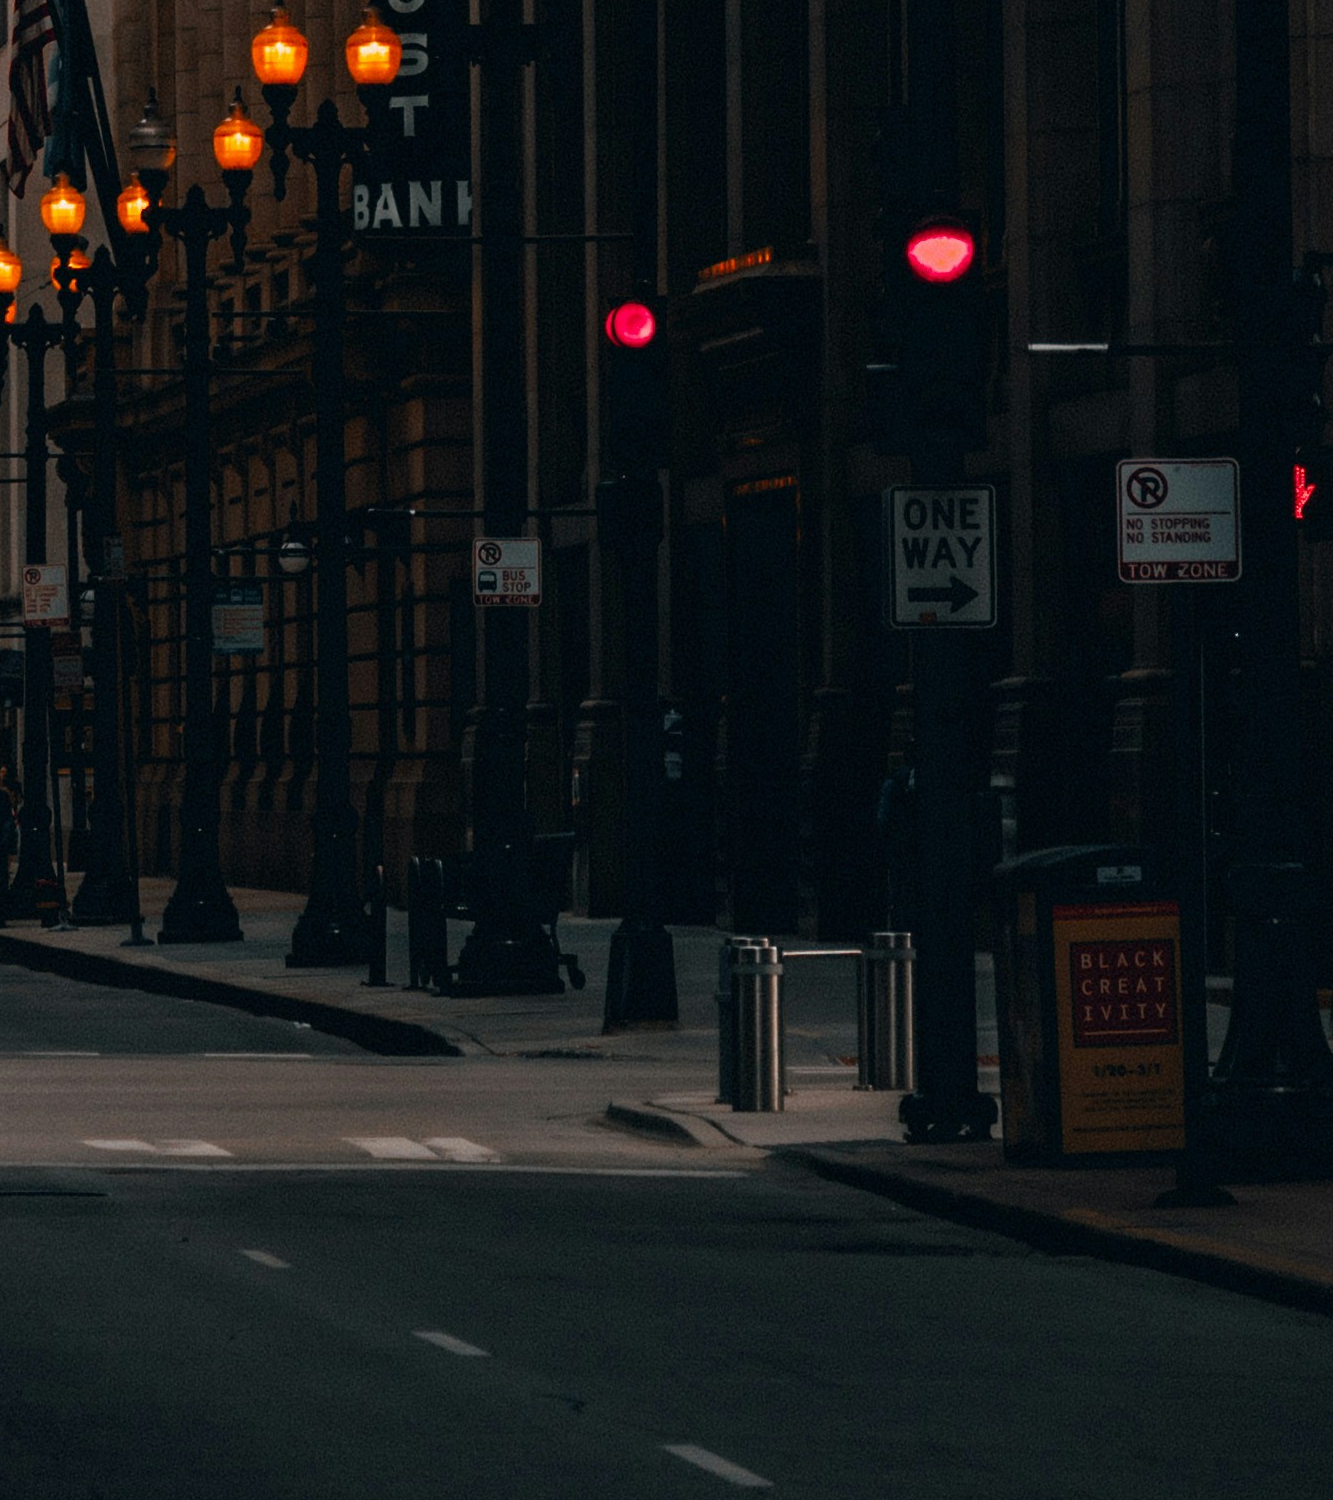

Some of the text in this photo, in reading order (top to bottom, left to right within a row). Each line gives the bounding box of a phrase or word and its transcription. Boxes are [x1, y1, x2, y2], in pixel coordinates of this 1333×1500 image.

[903, 498, 981, 531] ONE
[1126, 517, 1211, 530] NO STOPPING
[1126, 531, 1212, 544] NO STANDING
[902, 537, 982, 569] WAY
[502, 570, 526, 581] BUS
[1128, 562, 1229, 580] TOW ZONE
[502, 581, 532, 593] STOP
[1080, 950, 1165, 970] BLACK
[1080, 976, 1165, 996] CREAT
[1083, 1002, 1168, 1022] IVITY
